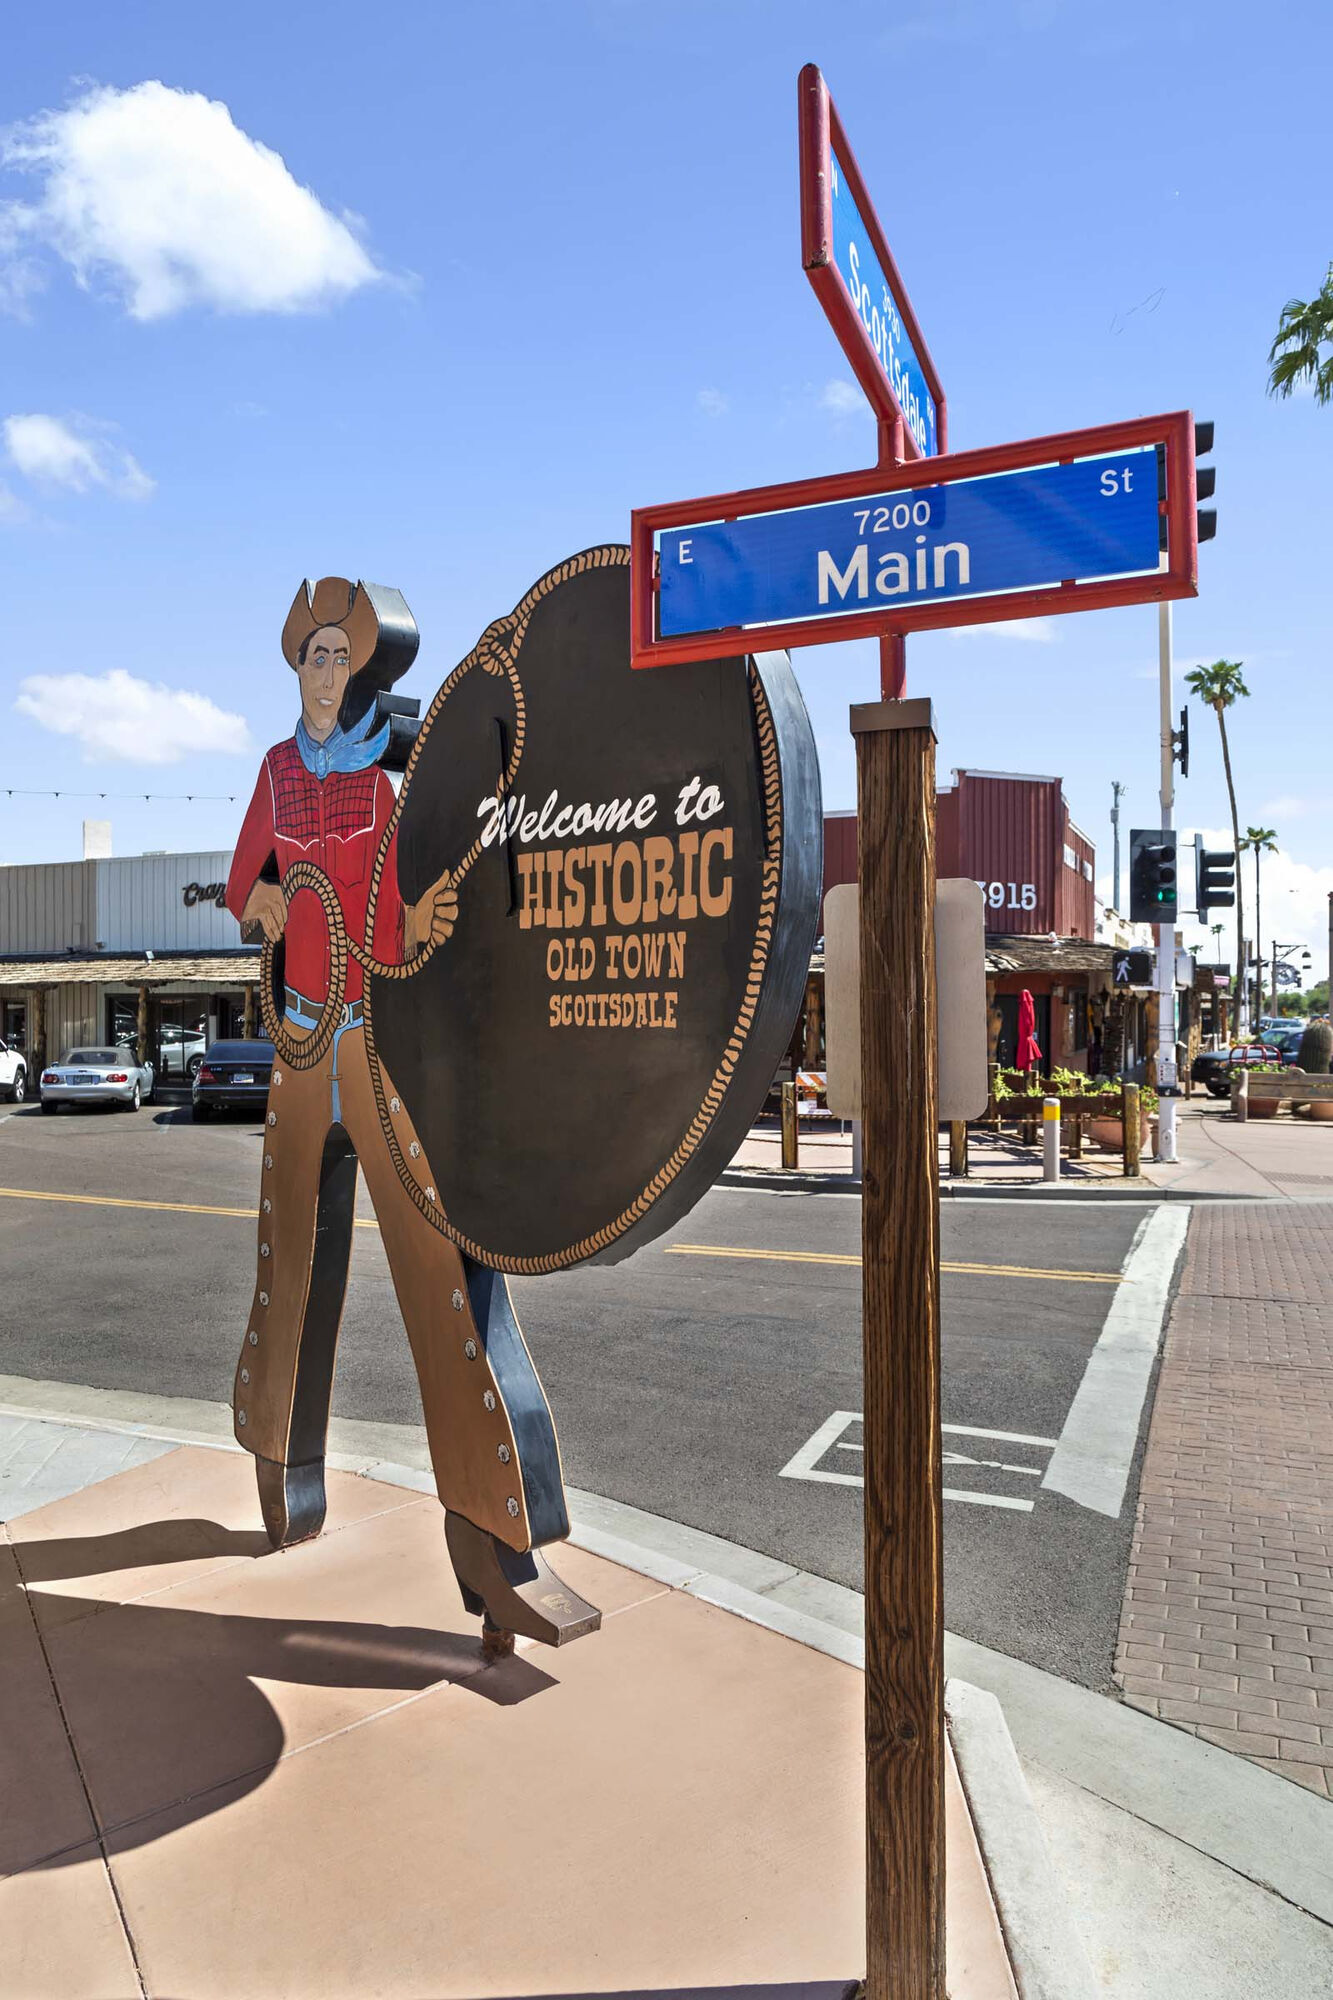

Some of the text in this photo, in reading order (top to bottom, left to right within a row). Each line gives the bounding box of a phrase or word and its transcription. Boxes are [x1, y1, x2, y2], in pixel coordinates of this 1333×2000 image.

[849, 241, 926, 457] Scottsdale
[1099, 466, 1134, 497] St
[853, 500, 931, 535] 7200
[678, 539, 694, 564] E
[816, 535, 971, 604] Main
[477, 776, 725, 848] Welcome to
[517, 827, 733, 929] HISTORIC
[546, 931, 687, 981] OLD TOWN
[549, 991, 679, 1028] SCOTTSDALE
